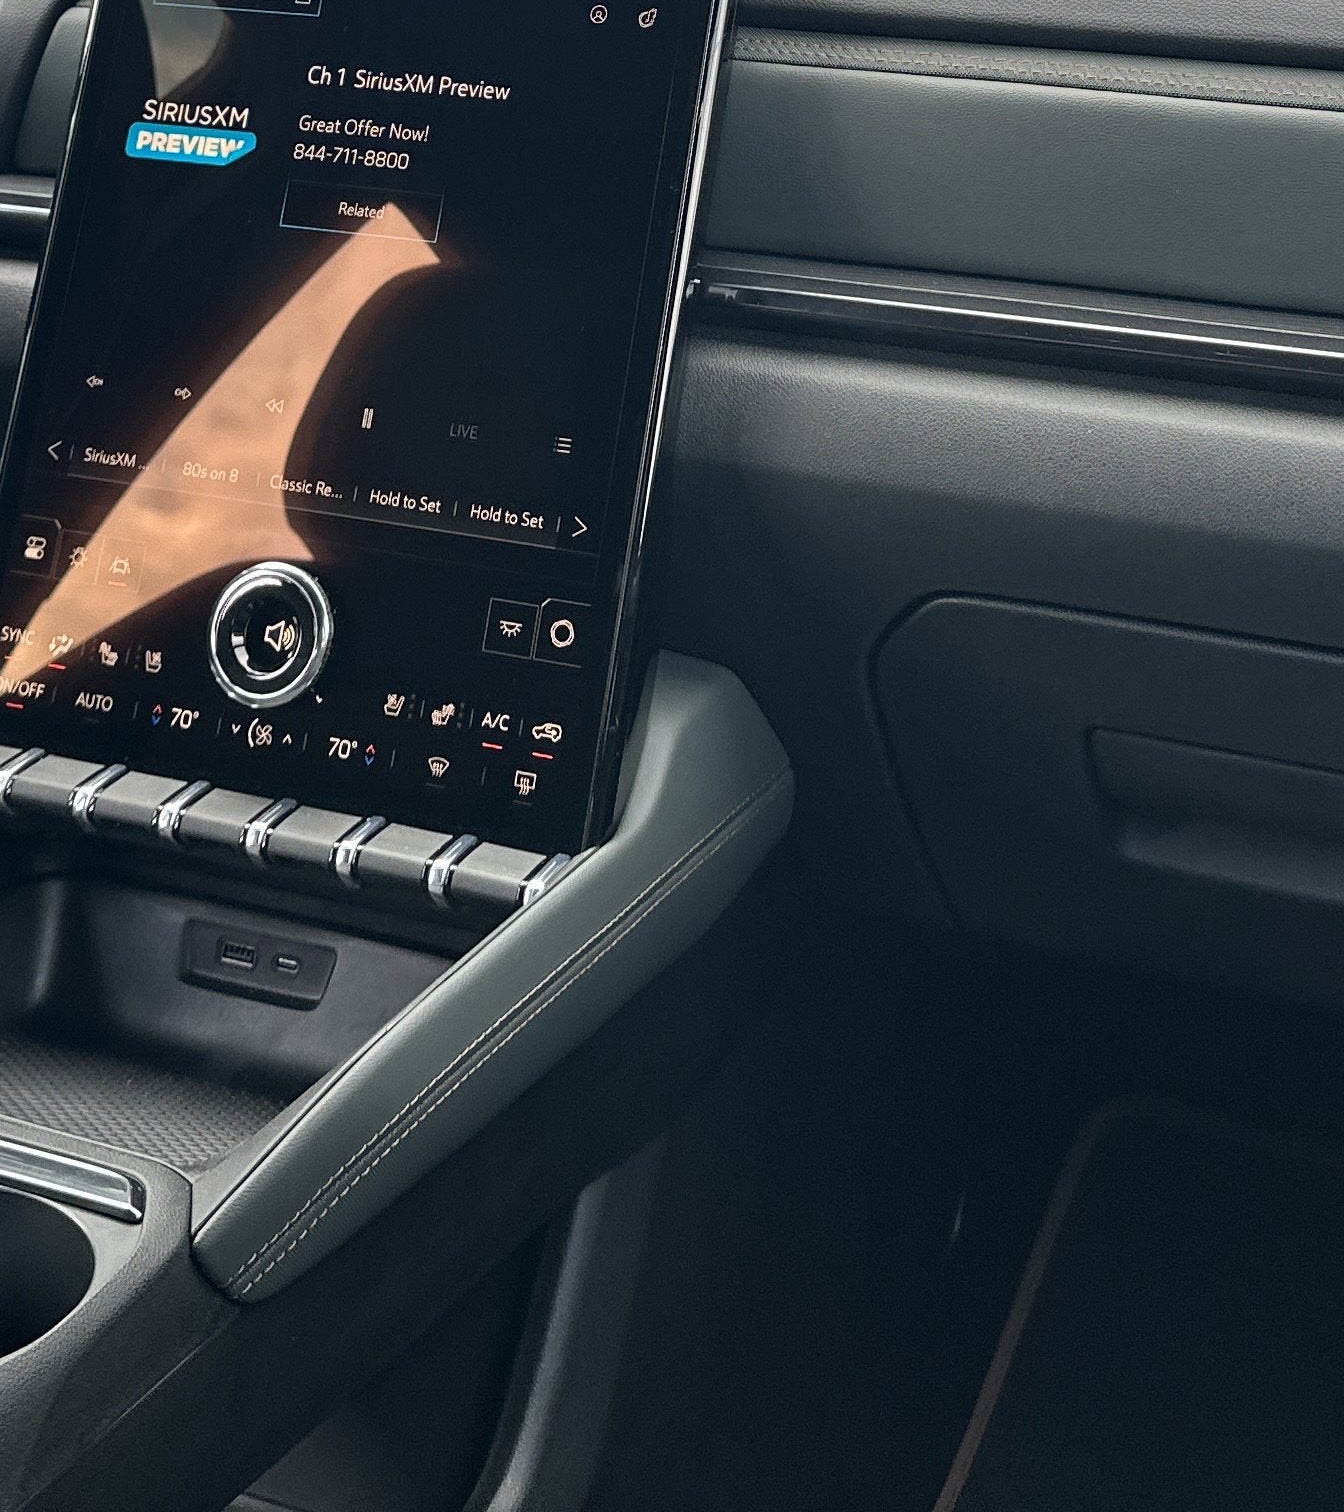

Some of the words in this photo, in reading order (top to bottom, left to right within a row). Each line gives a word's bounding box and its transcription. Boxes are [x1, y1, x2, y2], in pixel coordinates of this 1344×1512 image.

[307, 65, 332, 87] Ch
[337, 67, 346, 87] 1
[353, 69, 434, 95] SiriusXM
[438, 76, 511, 101] Preview
[142, 99, 249, 129] SIRIUSXM
[298, 114, 341, 135] Great
[344, 118, 387, 139] Offer
[389, 122, 431, 143] Now!
[135, 129, 245, 158] PREVIEW
[292, 143, 410, 171] 844-711-8800
[338, 201, 385, 221] Related
[449, 422, 479, 439] LIVE
[83, 446, 137, 468] SiriusXM
[182, 461, 207, 479] 80s
[210, 469, 226, 481] on
[228, 468, 239, 483] 8
[269, 474, 312, 495] Classic
[315, 480, 343, 499] Re...
[369, 489, 400, 508] Hold
[403, 493, 417, 509] to
[419, 496, 441, 514] Set
[470, 504, 501, 523] Hold
[504, 510, 518, 525] to
[521, 512, 544, 530] Set
[0, 625, 36, 646] SYNC
[74, 691, 114, 712] AUTO
[169, 706, 200, 729] 70°
[481, 712, 510, 732] A/C
[327, 736, 358, 760] 70°
